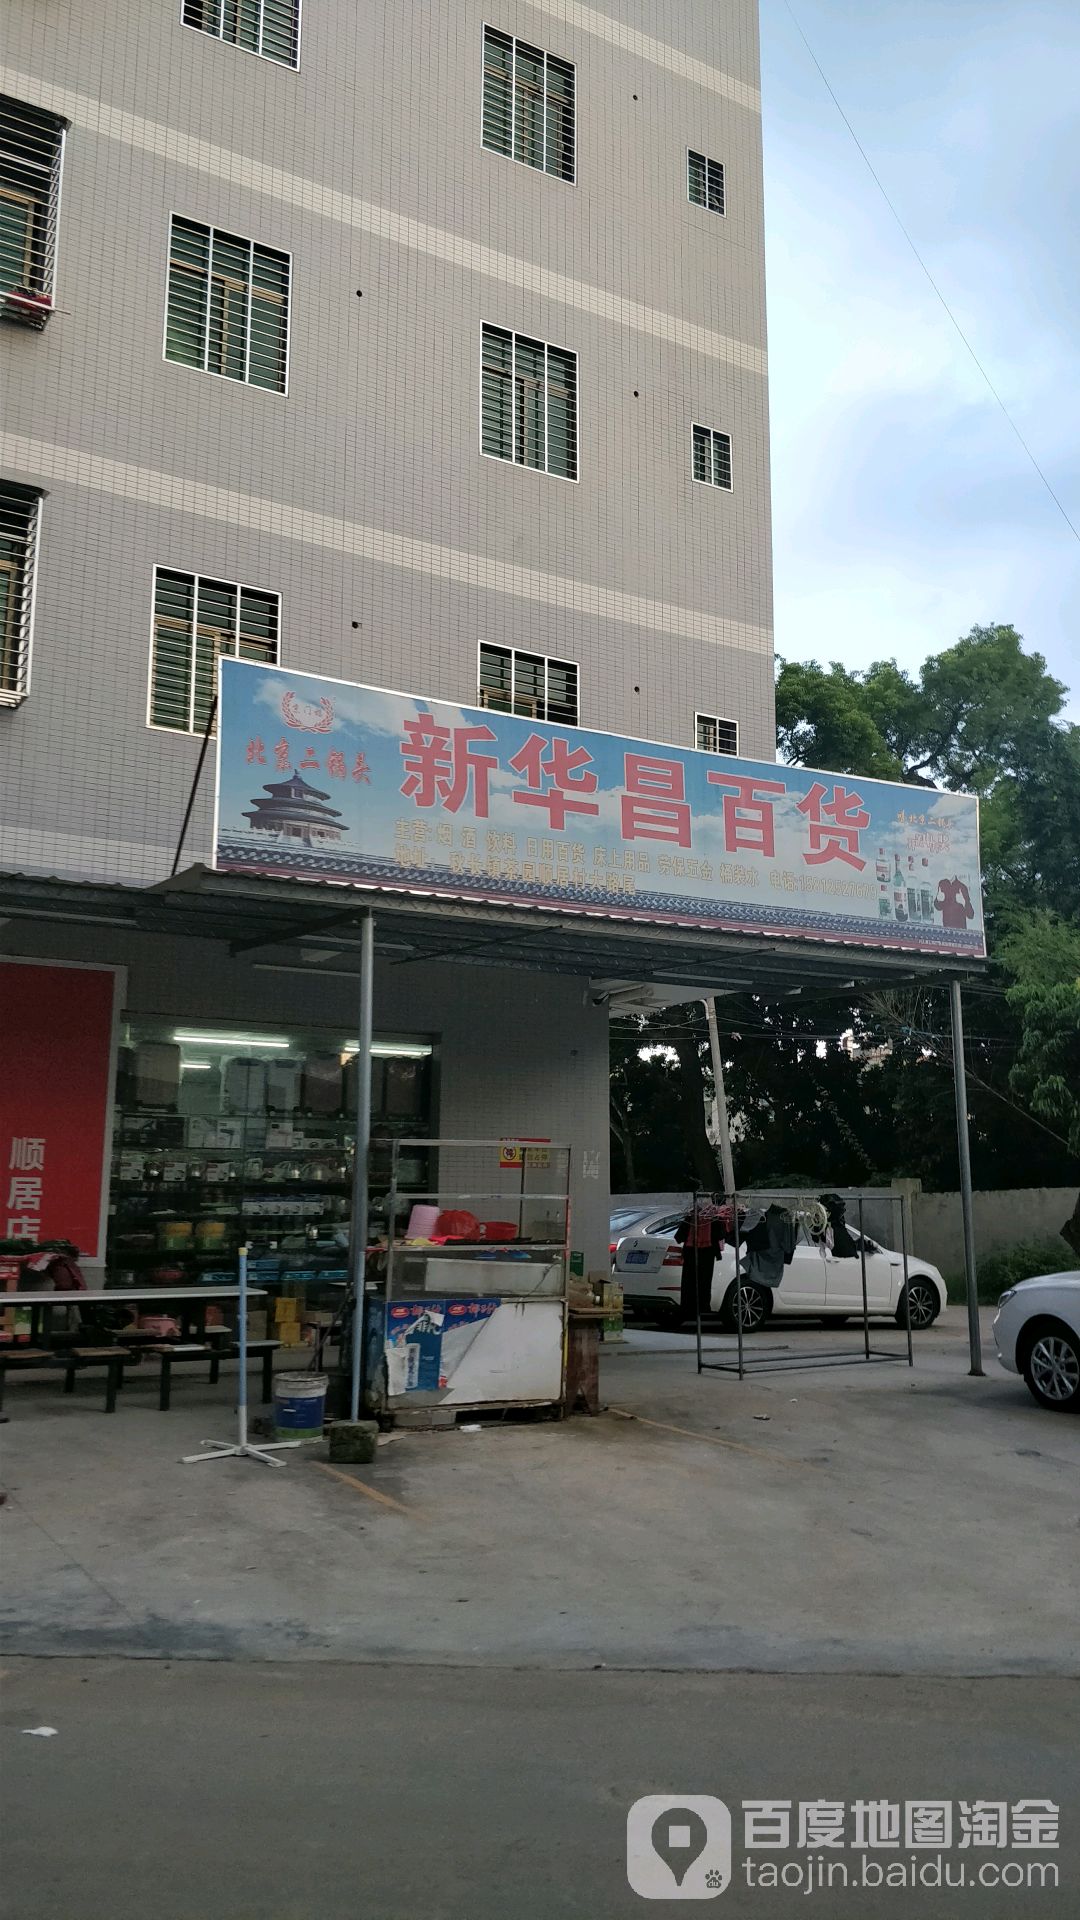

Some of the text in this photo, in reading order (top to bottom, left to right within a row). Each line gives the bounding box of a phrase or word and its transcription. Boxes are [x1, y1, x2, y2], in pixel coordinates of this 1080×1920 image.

[246, 735, 372, 784] 北京二锅头
[400, 712, 871, 871] 新华昌百货
[436, 822, 453, 847] 烟
[461, 826, 477, 849] 酒
[487, 830, 517, 855] 饮料
[526, 836, 586, 865] 日用百货
[592, 846, 651, 873] 床上用品
[656, 854, 714, 881] 劳保五金
[719, 862, 759, 887] 桶装水
